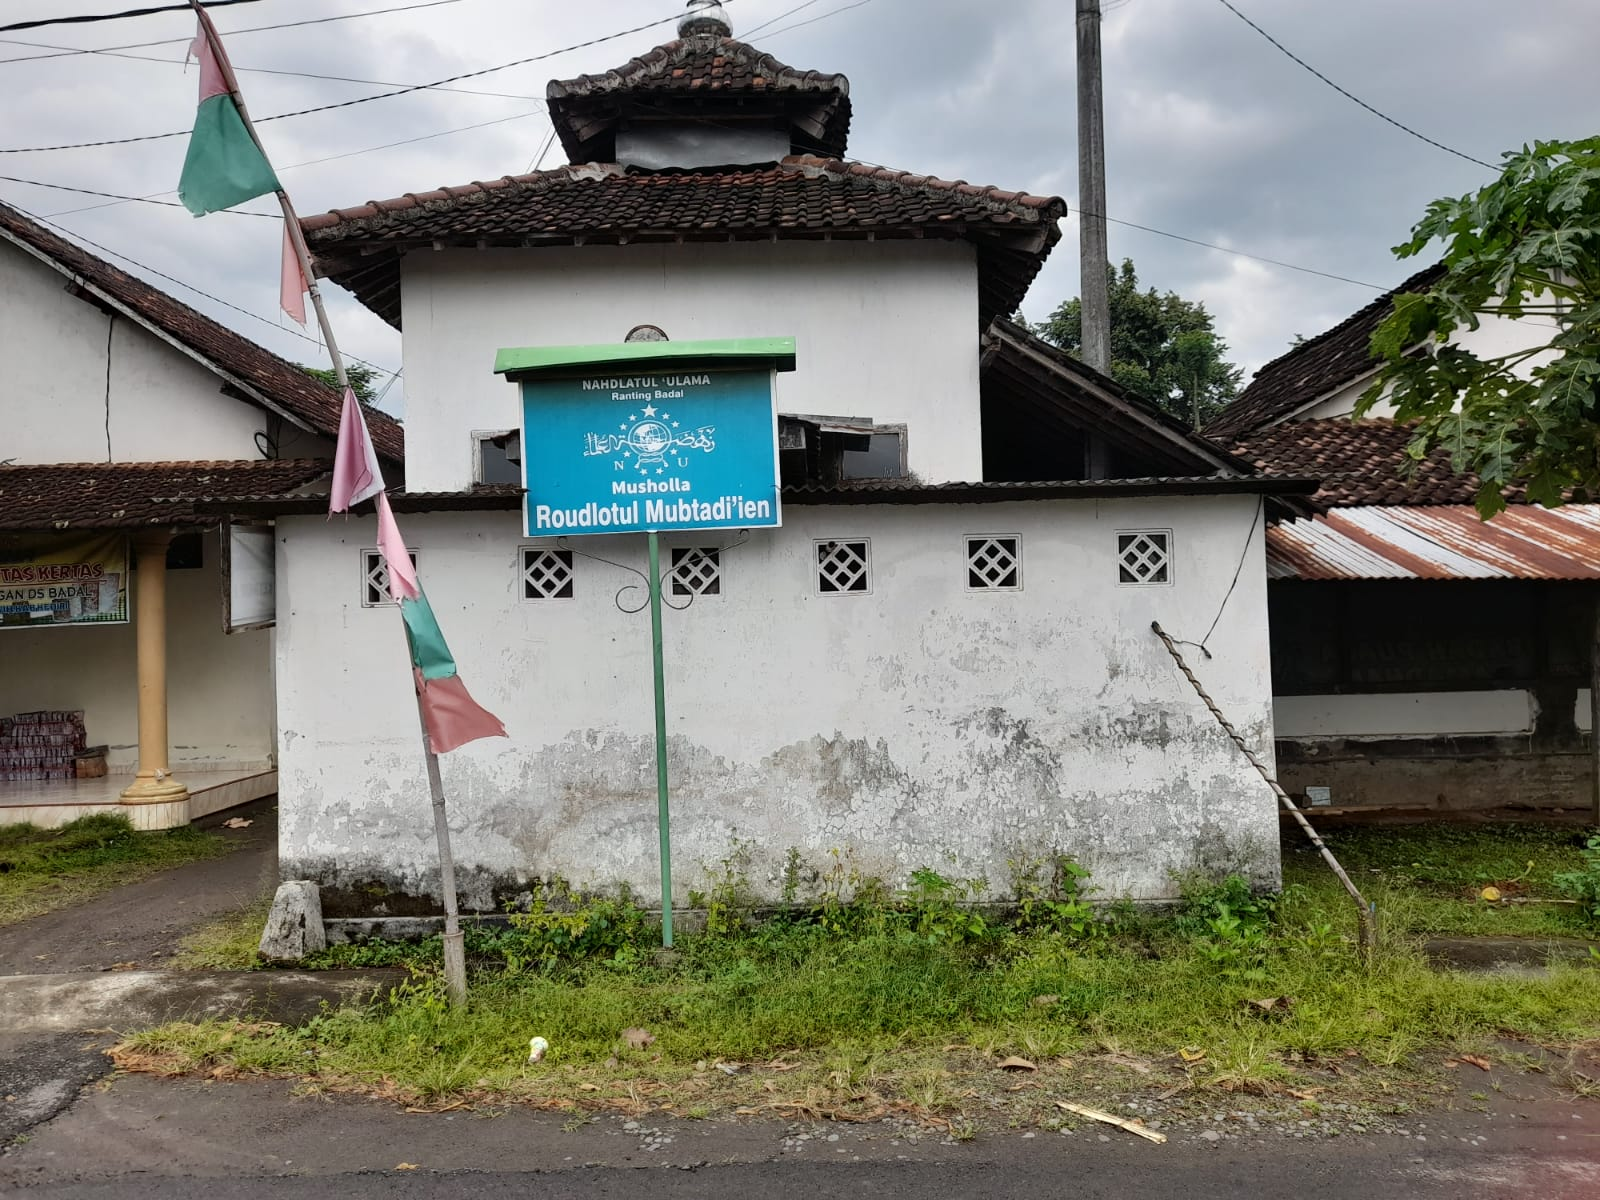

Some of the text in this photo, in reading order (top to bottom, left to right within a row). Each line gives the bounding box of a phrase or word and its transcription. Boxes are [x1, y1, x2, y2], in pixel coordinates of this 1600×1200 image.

[582, 377, 658, 390] NAHDLATUL
[611, 389, 684, 402] Ranting Badal
[614, 457, 689, 471] N U
[612, 478, 691, 495] Musholla
[536, 500, 639, 529] Roudlotul
[37, 563, 105, 580] KERTAS
[28, 588, 45, 600] DS
[48, 585, 93, 598] BADAL
